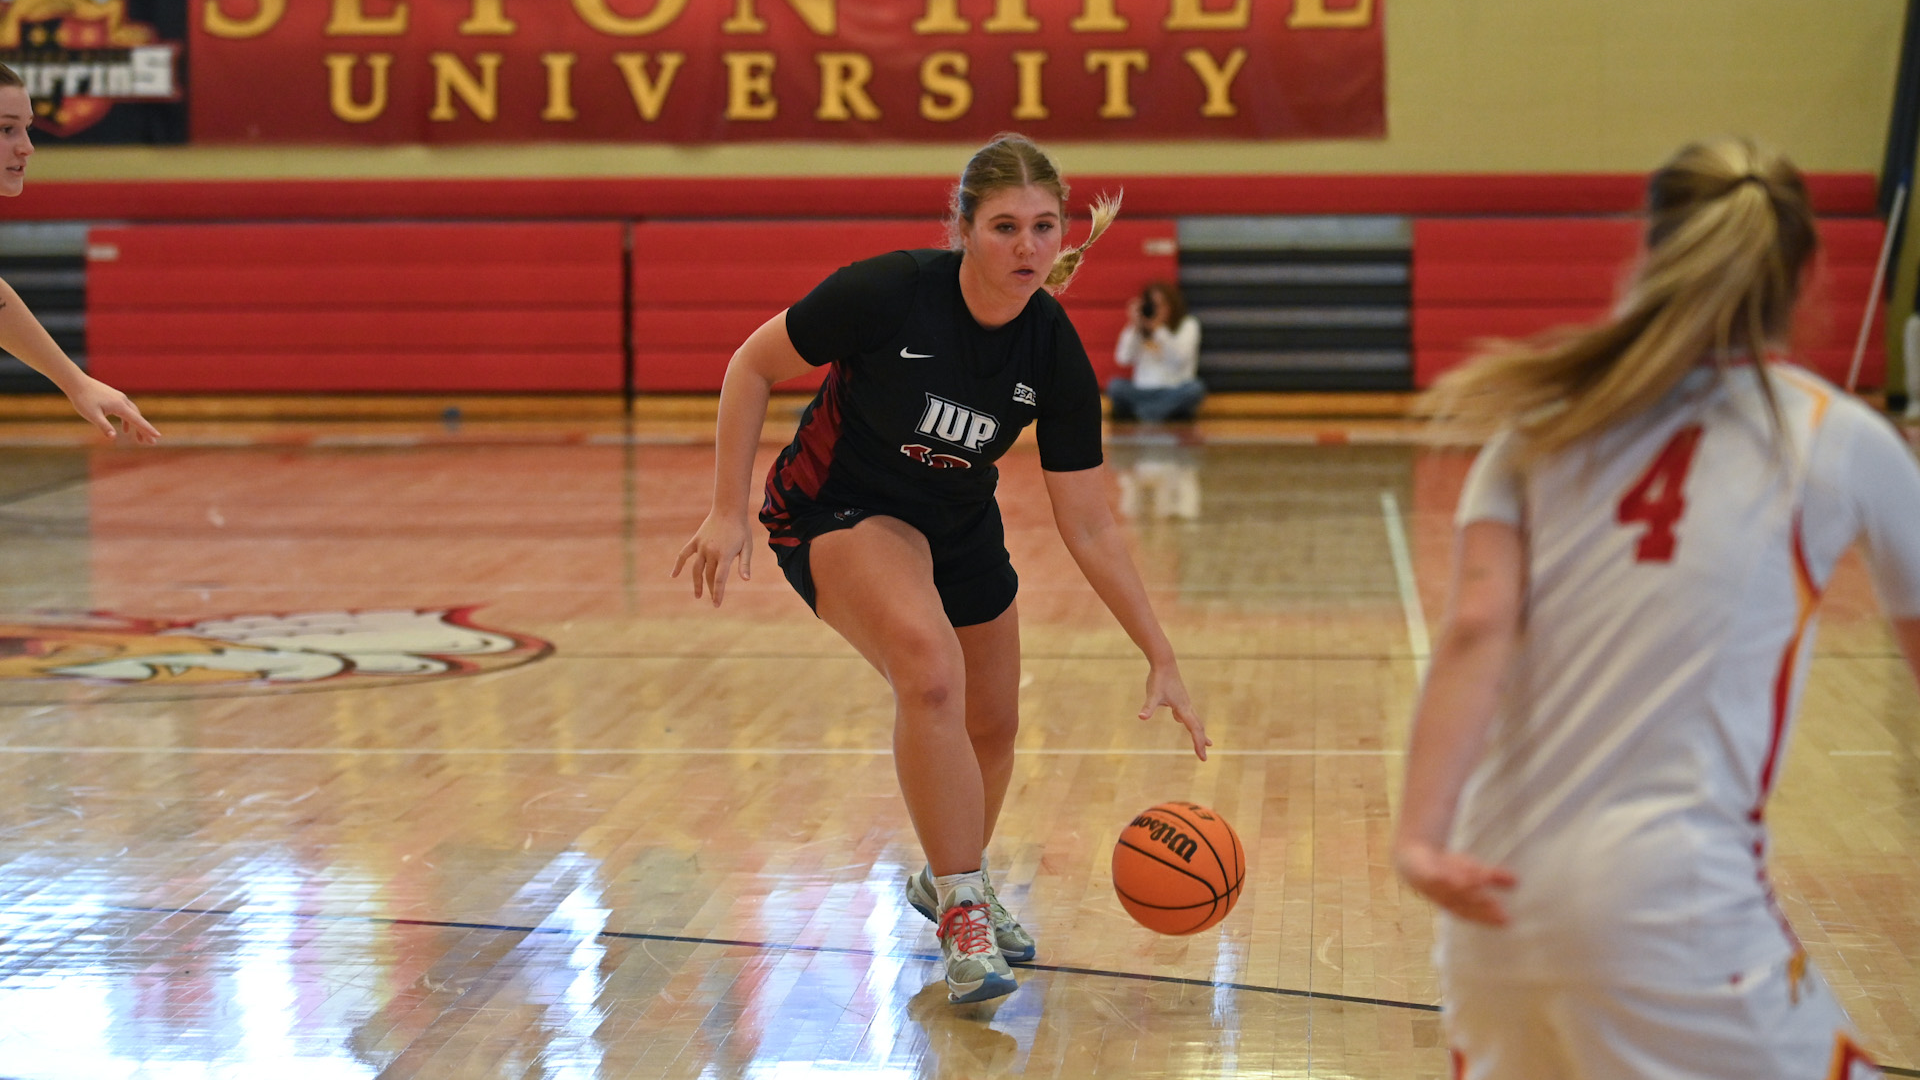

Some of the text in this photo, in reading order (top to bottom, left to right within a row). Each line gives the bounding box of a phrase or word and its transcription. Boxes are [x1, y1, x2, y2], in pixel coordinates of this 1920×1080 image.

[326, 50, 1247, 121] UNIVERSITY
[918, 396, 998, 451] IUP
[1616, 423, 1704, 563] 4
[1130, 815, 1198, 863] Wilson
